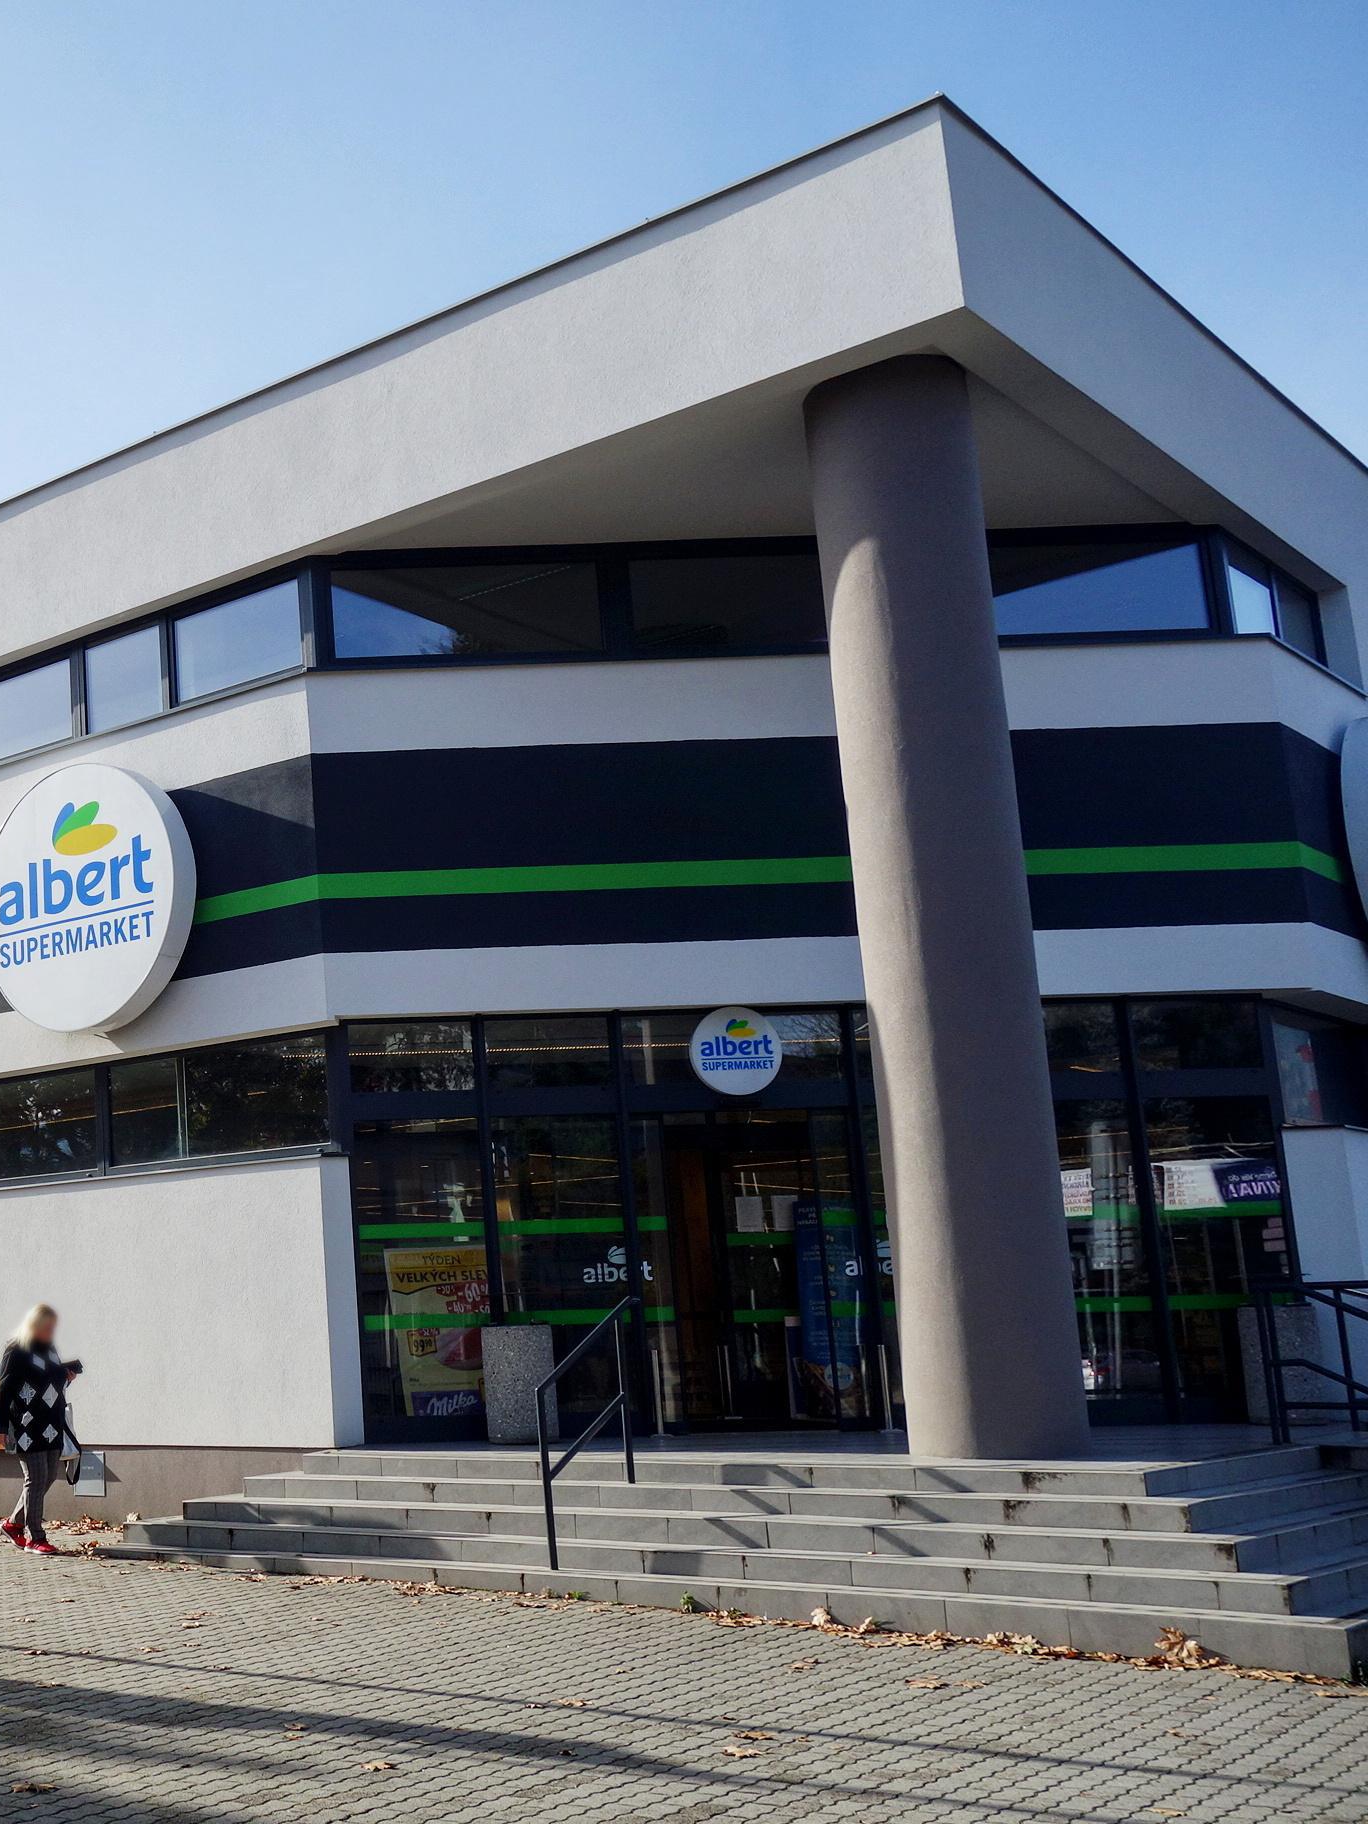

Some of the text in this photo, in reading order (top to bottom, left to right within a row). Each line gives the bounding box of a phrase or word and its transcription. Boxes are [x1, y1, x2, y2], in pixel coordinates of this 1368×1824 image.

[0, 911, 154, 969] SUPERMARKET
[701, 1035, 773, 1056] albert
[702, 1060, 774, 1071] SUPERMARKET
[422, 1252, 461, 1265] TÝDEN
[395, 1268, 456, 1283] VELKÝCH
[582, 1260, 654, 1283] albet
[426, 1392, 478, 1416] Milka
